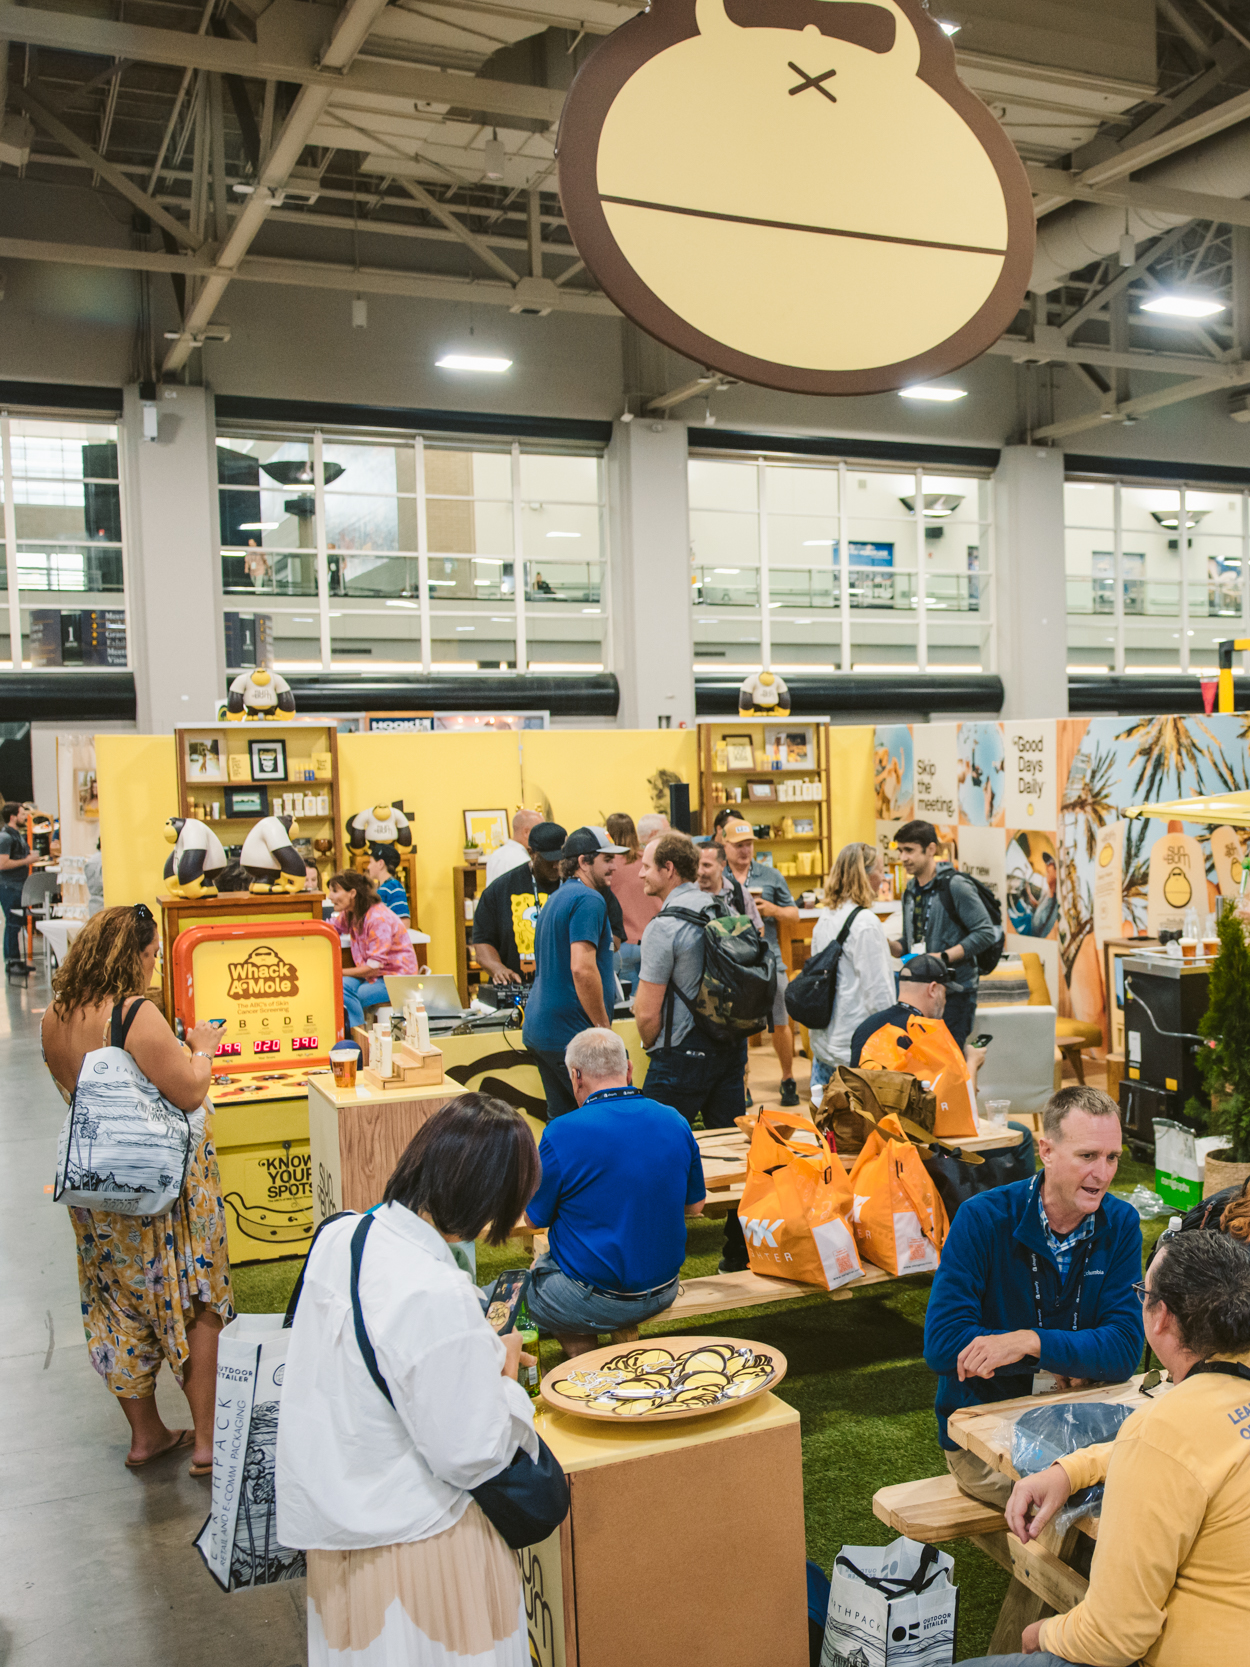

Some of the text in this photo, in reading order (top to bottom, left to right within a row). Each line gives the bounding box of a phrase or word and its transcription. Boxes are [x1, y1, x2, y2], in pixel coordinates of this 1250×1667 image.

[917, 759, 937, 779] Skip
[1018, 756, 1043, 775] Days
[918, 778, 931, 794] the
[1018, 777, 1046, 799] Daily
[229, 962, 291, 980] Whack
[239, 1020, 247, 1028] B
[261, 1018, 269, 1027] C
[284, 1016, 292, 1025] D
[306, 1015, 314, 1024] E
[254, 1040, 280, 1051] 020
[292, 1037, 319, 1049] 390
[230, 1400, 247, 1459] PACKAGING
[222, 1465, 237, 1512] E-COMM
[220, 1513, 229, 1537] AND
[923, 1613, 952, 1624] OUTDOOR
[923, 1619, 948, 1630] RETAILER
